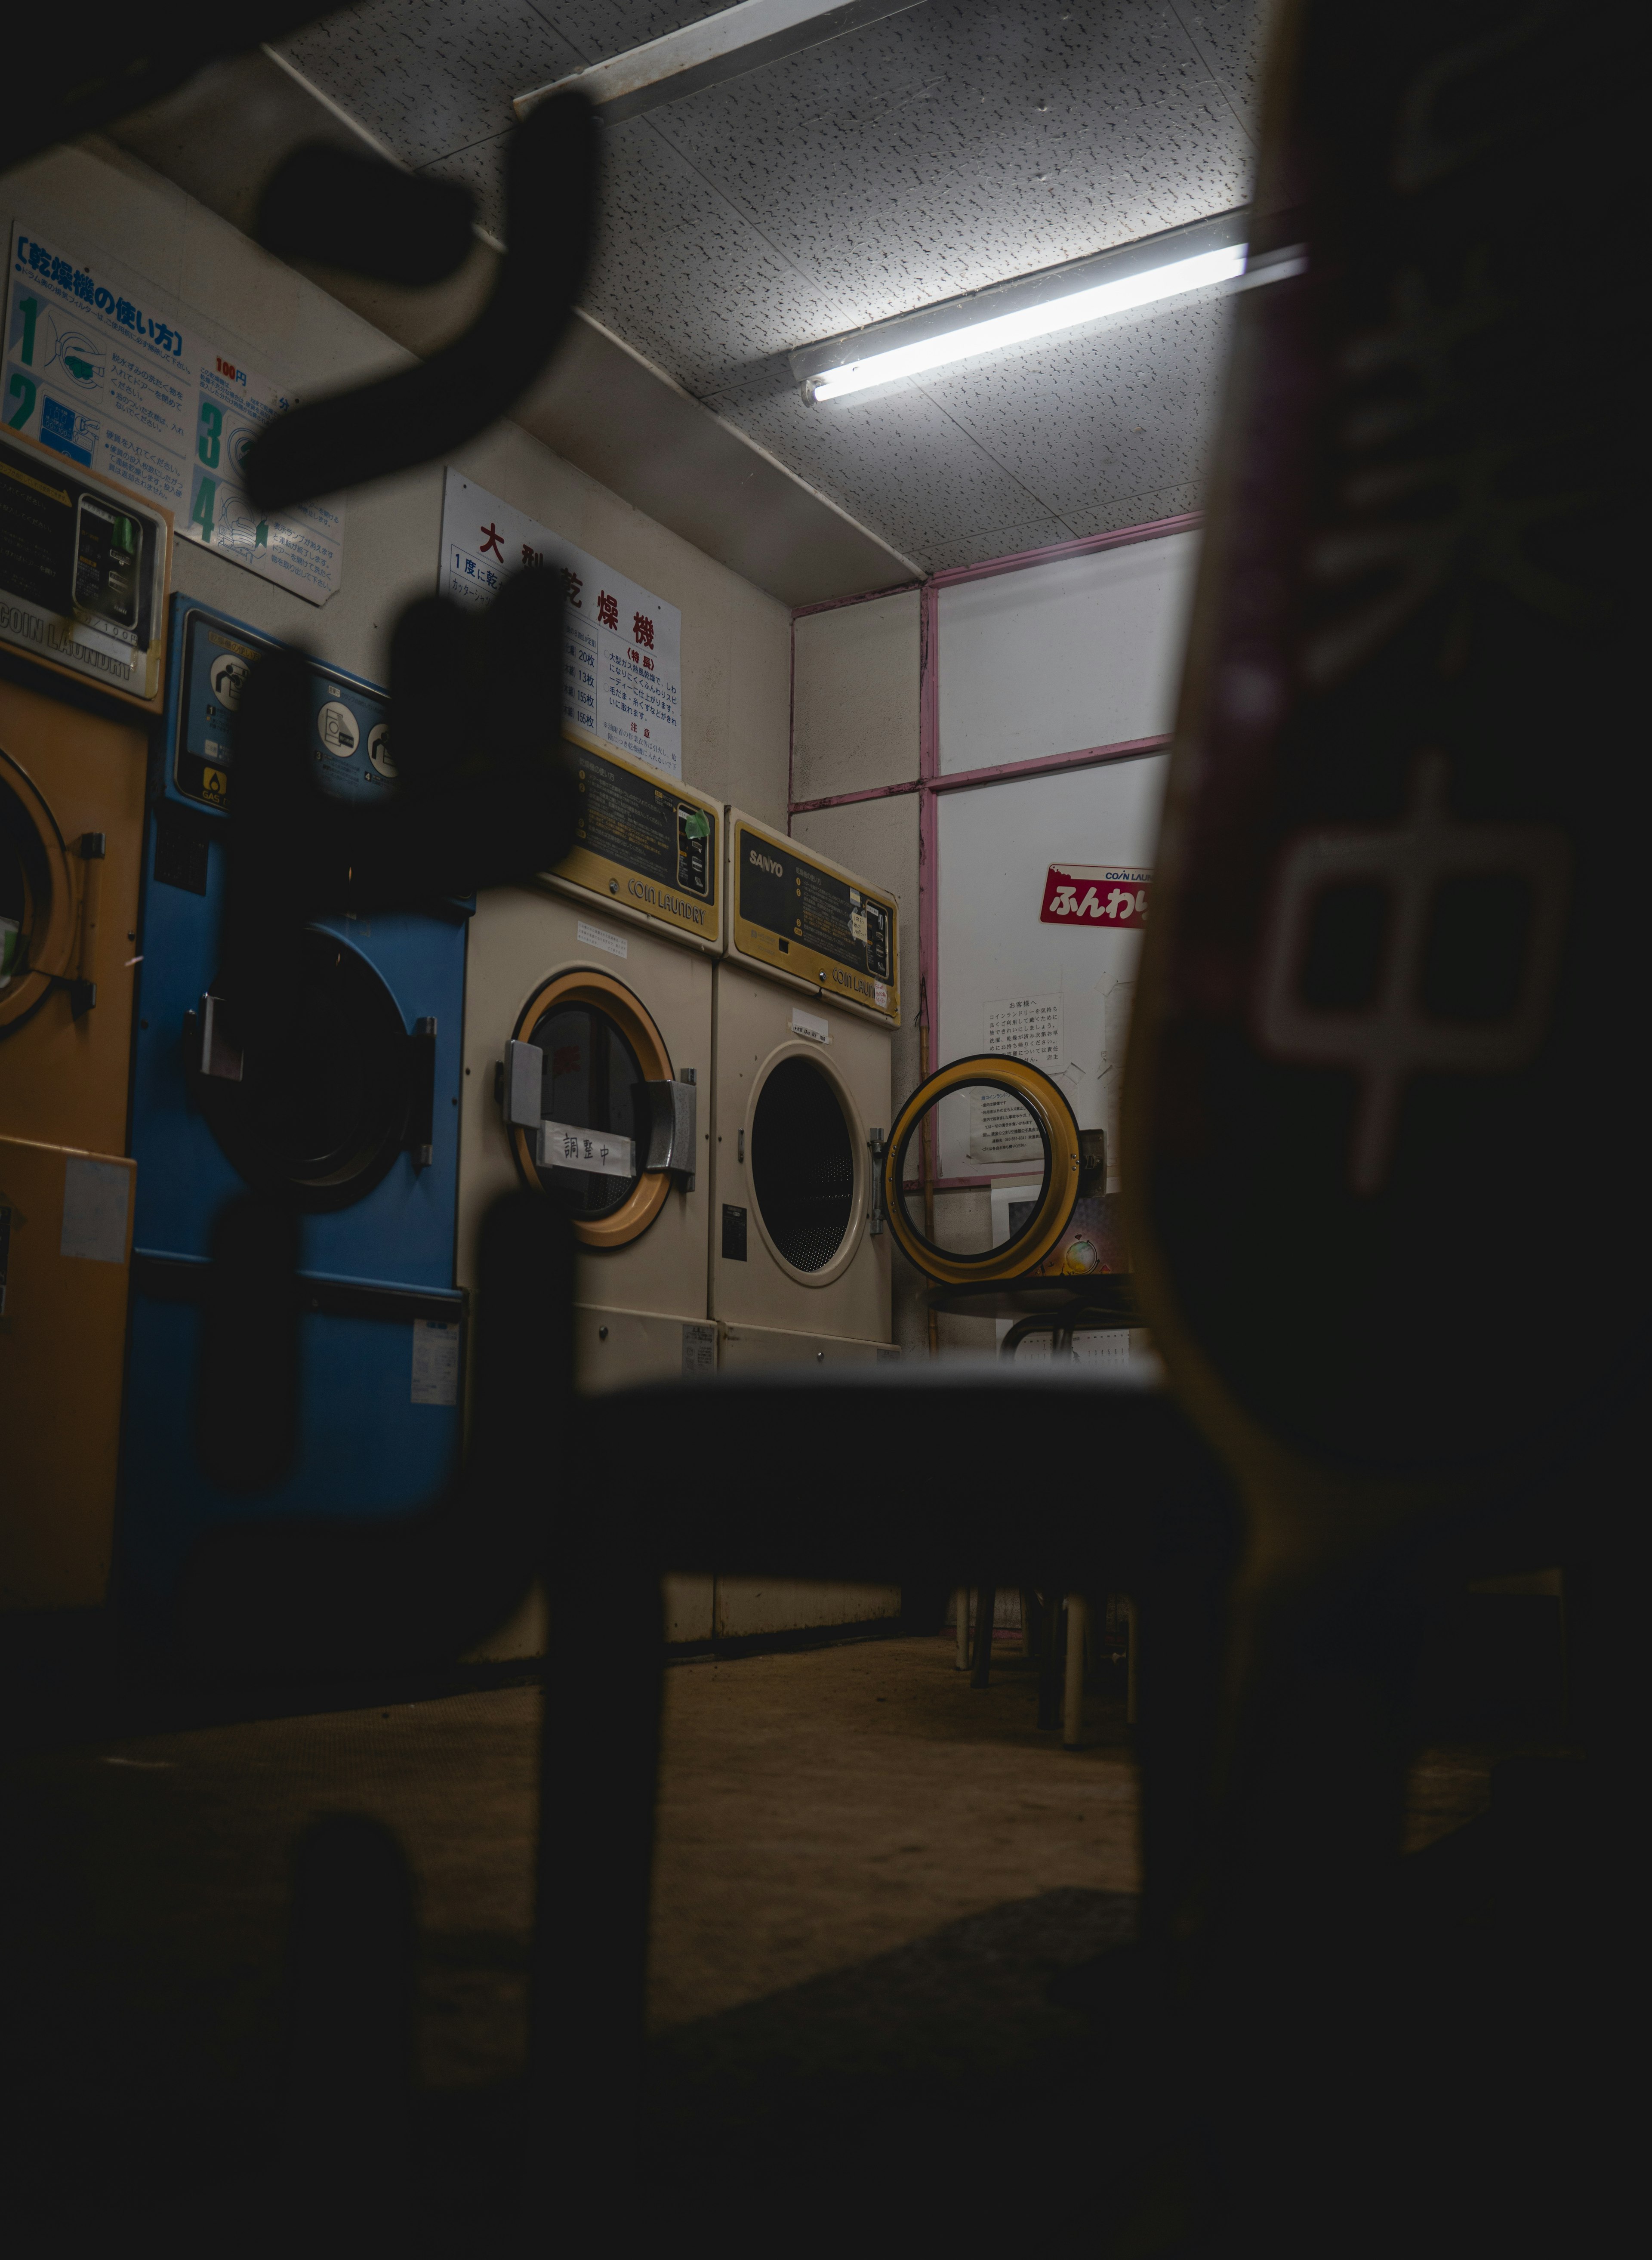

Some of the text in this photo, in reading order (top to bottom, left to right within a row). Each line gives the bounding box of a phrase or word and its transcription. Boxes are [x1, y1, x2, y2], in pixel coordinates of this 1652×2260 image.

[19, 296, 38, 367] 1
[111, 374, 143, 401] ください。
[111, 364, 182, 413] 入れてドアーを閉めて
[112, 352, 183, 401] 脱水ずみの洗たく物を
[10, 373, 37, 432] 2
[115, 400, 162, 434] ないでください。
[106, 429, 180, 477] 硬貨を入れてください。
[198, 402, 222, 470] 3
[109, 463, 167, 500] 貨は返却されません。
[110, 454, 182, 498] て連続乾燥します。投入硬
[192, 475, 216, 543] 4
[273, 533, 329, 570] と運転が終了します。
[274, 522, 333, 559] 表示ランプが消えます
[271, 554, 331, 592] 物を取り出して下さい。
[272, 543, 331, 581] ドアーを開けて洗たく
[0, 602, 44, 643] COIN
[579, 648, 595, 668] 20枚
[610, 653, 676, 695] 大型ガス熱風乾燥で、しわ
[578, 669, 594, 688] 13枚
[610, 663, 676, 705] になりにくくふんわりスピ
[610, 674, 675, 716] ーディーに仕上がります。
[609, 696, 647, 724] いに取れます。
[631, 721, 650, 740] 注意
[203, 790, 220, 803] GAS
[749, 850, 783, 878] SANYO
[1106, 870, 1154, 882] COIN LAUN
[628, 878, 706, 925] COIN LAUNDRY
[832, 967, 853, 992] COIN
[989, 1006, 1057, 1020] コインランドリーを気持ち
[989, 1014, 1058, 1028] 良くご利用して戴くために
[1009, 1000, 1037, 1009] お客様へ
[989, 1023, 1055, 1036] 皆できれいにしましょう。
[989, 1030, 1058, 1044] 洗濯、乾燥が済み次第お早
[989, 1039, 1055, 1051] めにお持ち帰りください。
[985, 1120, 1033, 1129] ては一切の責任を負いかねます
[563, 1133, 609, 1166] 調整中
